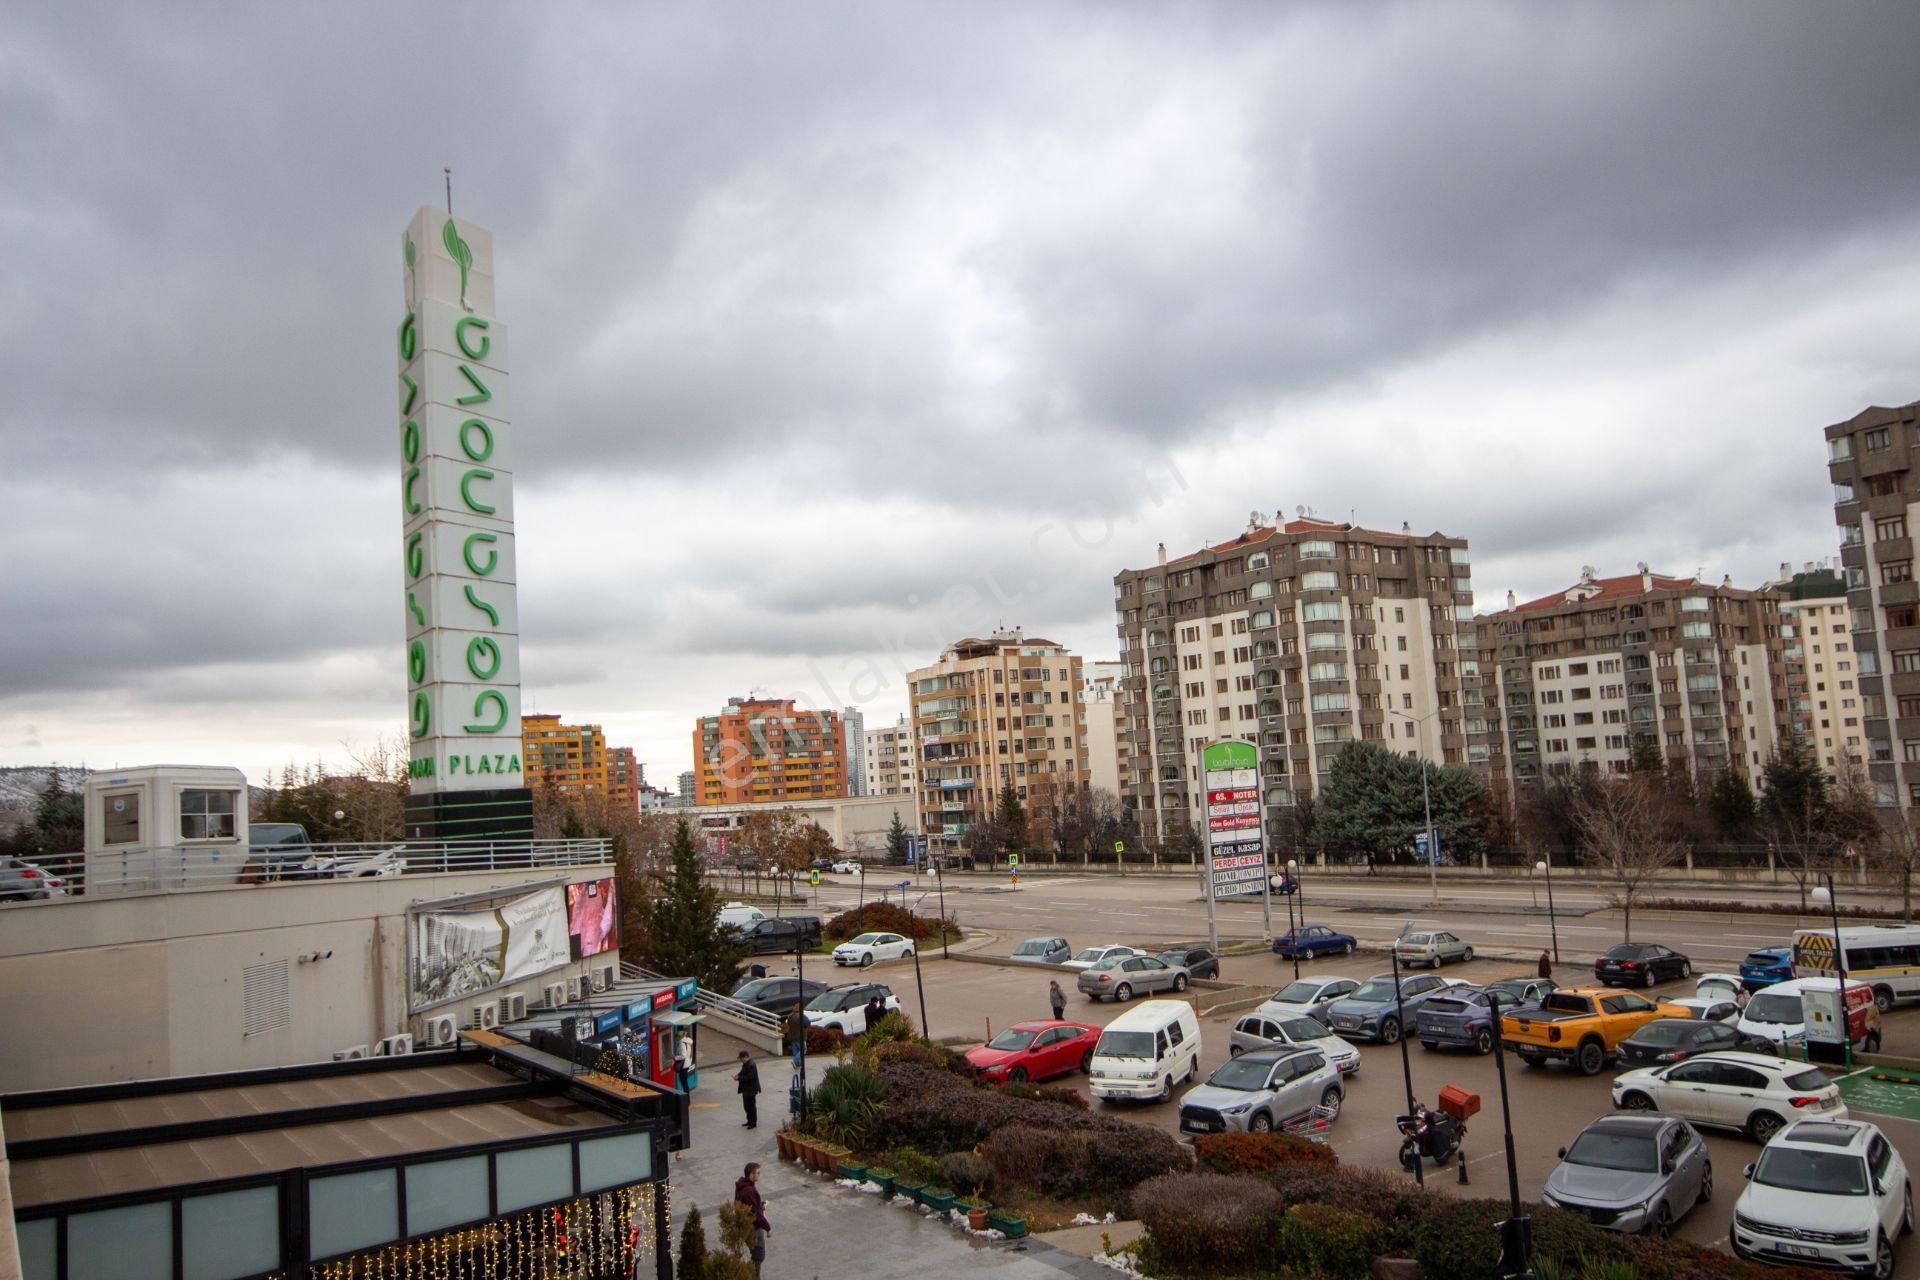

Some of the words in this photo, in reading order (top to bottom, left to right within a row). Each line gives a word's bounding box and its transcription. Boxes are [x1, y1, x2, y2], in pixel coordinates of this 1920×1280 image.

[449, 752, 522, 776] PLAZA
[1233, 791, 1257, 800] NOTER
[1214, 858, 1237, 868] PERDE
